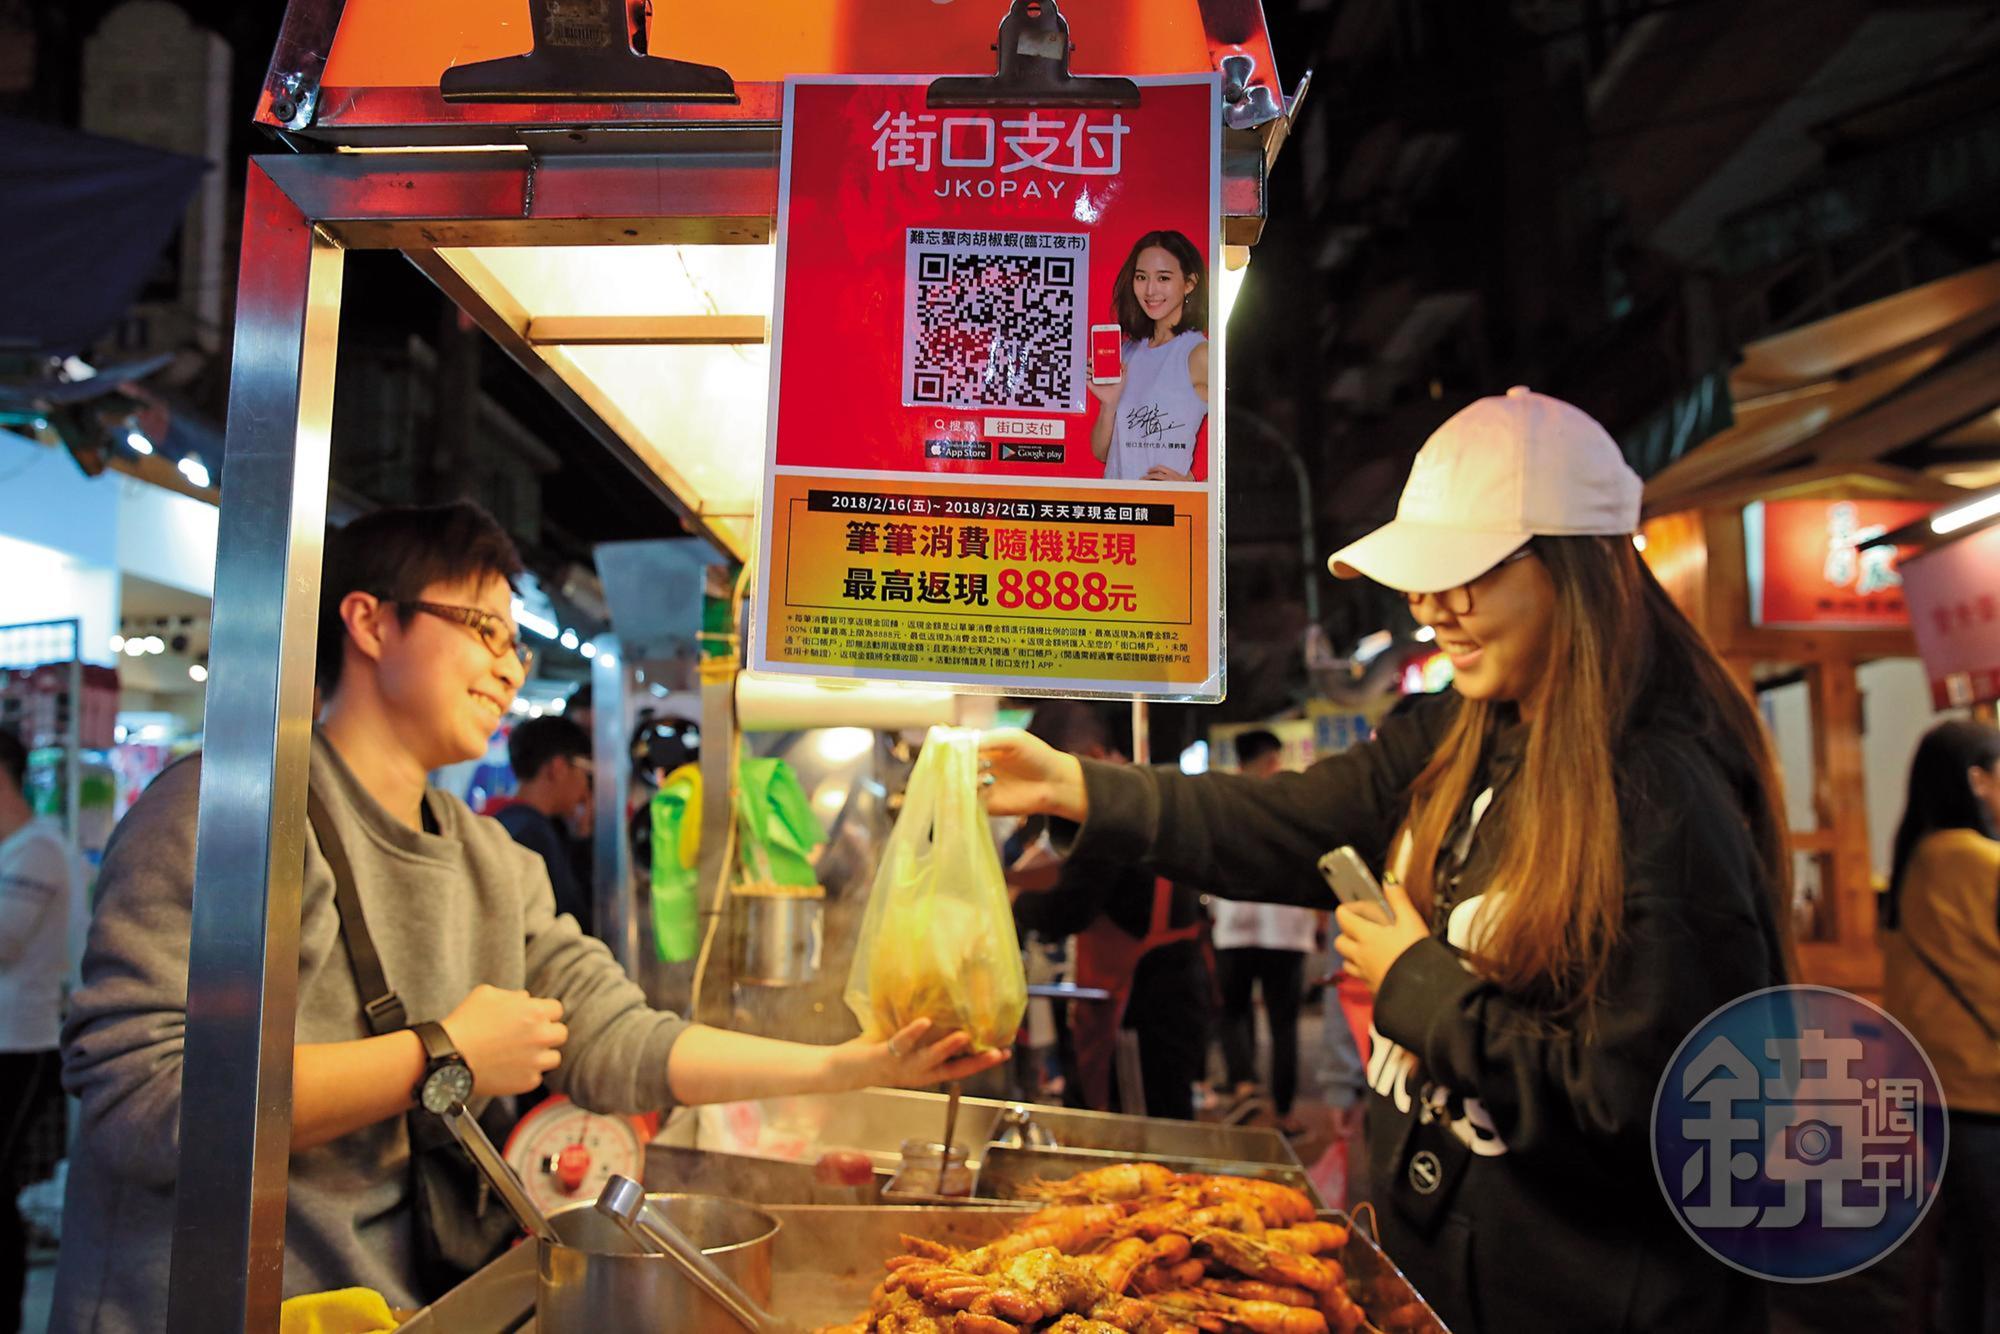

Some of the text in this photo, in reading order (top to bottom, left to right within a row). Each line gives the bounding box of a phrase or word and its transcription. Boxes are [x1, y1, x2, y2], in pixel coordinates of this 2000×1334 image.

[871, 110, 1131, 176] 街口支付
[934, 179, 1066, 199] JKOPAY
[910, 230, 1087, 251] 難忘蟹肉胡椒蝦(臨江夜市)
[996, 421, 1053, 436] 街口支付
[945, 448, 986, 458] App Store
[1017, 449, 1062, 461] Google play
[945, 501, 1035, 519] 2018/3/2(五)
[1040, 504, 1149, 522] 天天享現金回饋
[845, 520, 1137, 566] 筆筆消費隨機返現
[842, 567, 1137, 612] 最高返現8888元
